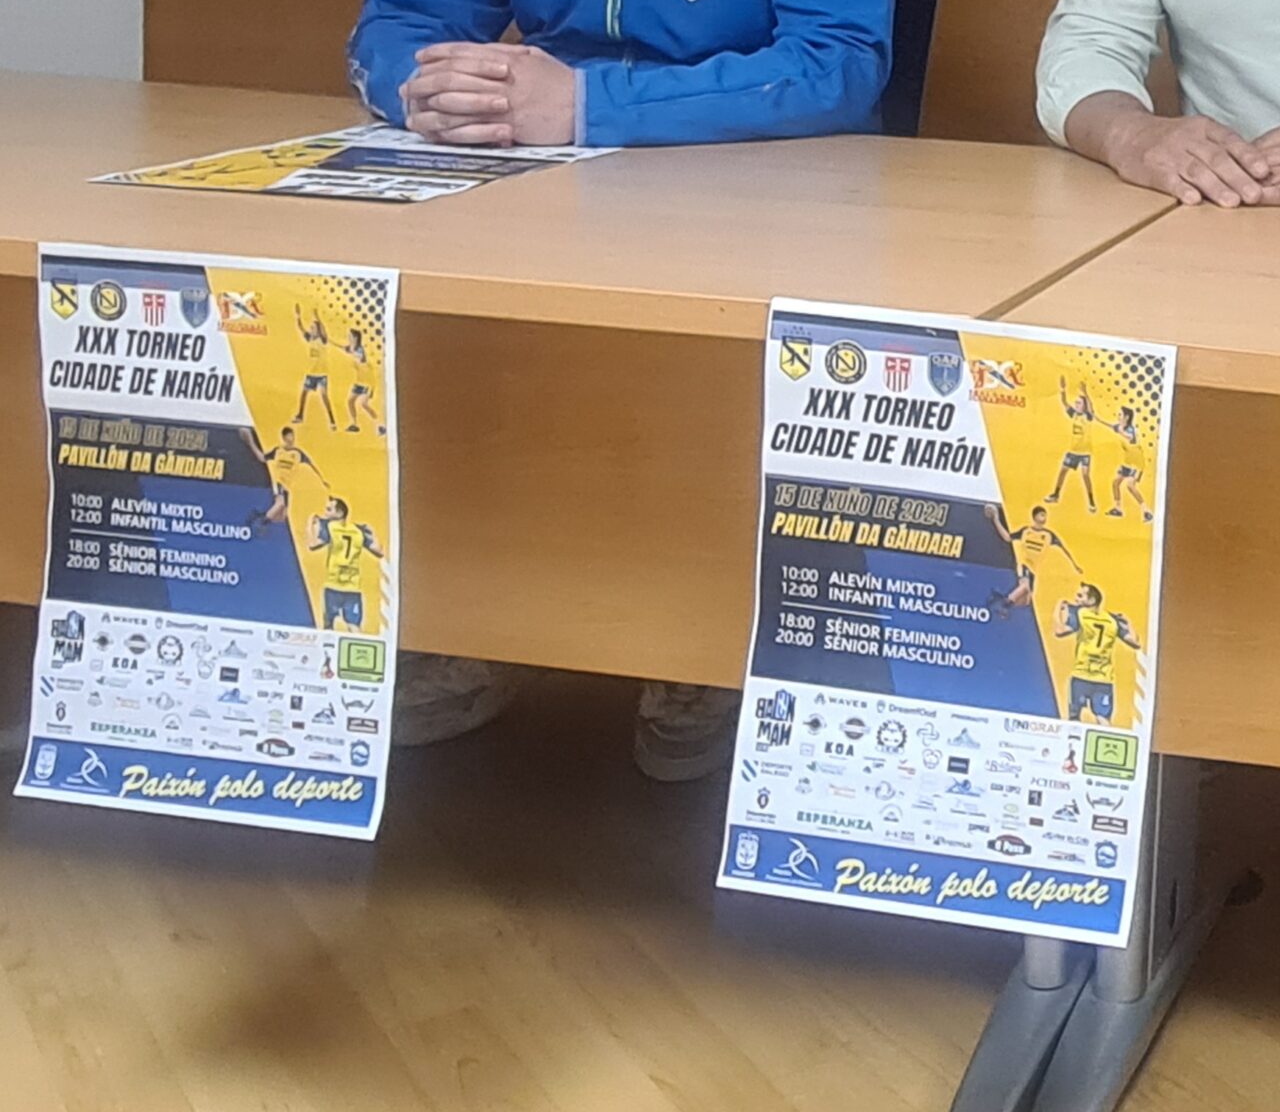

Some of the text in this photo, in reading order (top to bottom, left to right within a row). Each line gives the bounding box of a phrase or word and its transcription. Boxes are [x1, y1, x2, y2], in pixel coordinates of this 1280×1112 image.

[75, 325, 206, 362] XXX TORNEO
[49, 360, 235, 403] CIDADE DE NARÓN
[803, 387, 855, 420] XXX
[862, 394, 956, 431] TORNEO
[58, 444, 129, 470] PAVILLÓN
[131, 451, 153, 473] DA
[770, 422, 986, 476] CIDADE DE NARÓN
[71, 494, 203, 519] 10:00 ALEVÍN MIXTO
[774, 484, 949, 526] 15 DE XUÑO DE 2024
[70, 508, 251, 540] 12:00 INFANTIL MASCULINO
[771, 512, 964, 558] PAVILLÓN DA GÁNDARA
[69, 539, 226, 568] 18:00 SÉNIOR FEMININO
[342, 535, 352, 559] 7
[66, 554, 99, 570] 20:00
[159, 563, 239, 585] MASCULINO
[781, 565, 935, 598] 10:00 ALEVÍN MIXTO
[781, 582, 990, 623] 12:00 INFANTIL MASCULINO
[775, 629, 814, 647] 20:00
[882, 644, 974, 669] MASCULINO
[779, 613, 961, 651] 18:00 SÉNIOR FEMININO
[1093, 623, 1105, 648] 7
[90, 722, 157, 738] ESPERANZA
[119, 764, 206, 799] Paixón
[208, 769, 264, 806] polo
[273, 771, 363, 808] deporte
[797, 811, 873, 831] ESPERANZA
[833, 858, 931, 894] Paixón
[935, 867, 998, 905] polo
[1007, 871, 1109, 910] deporte
